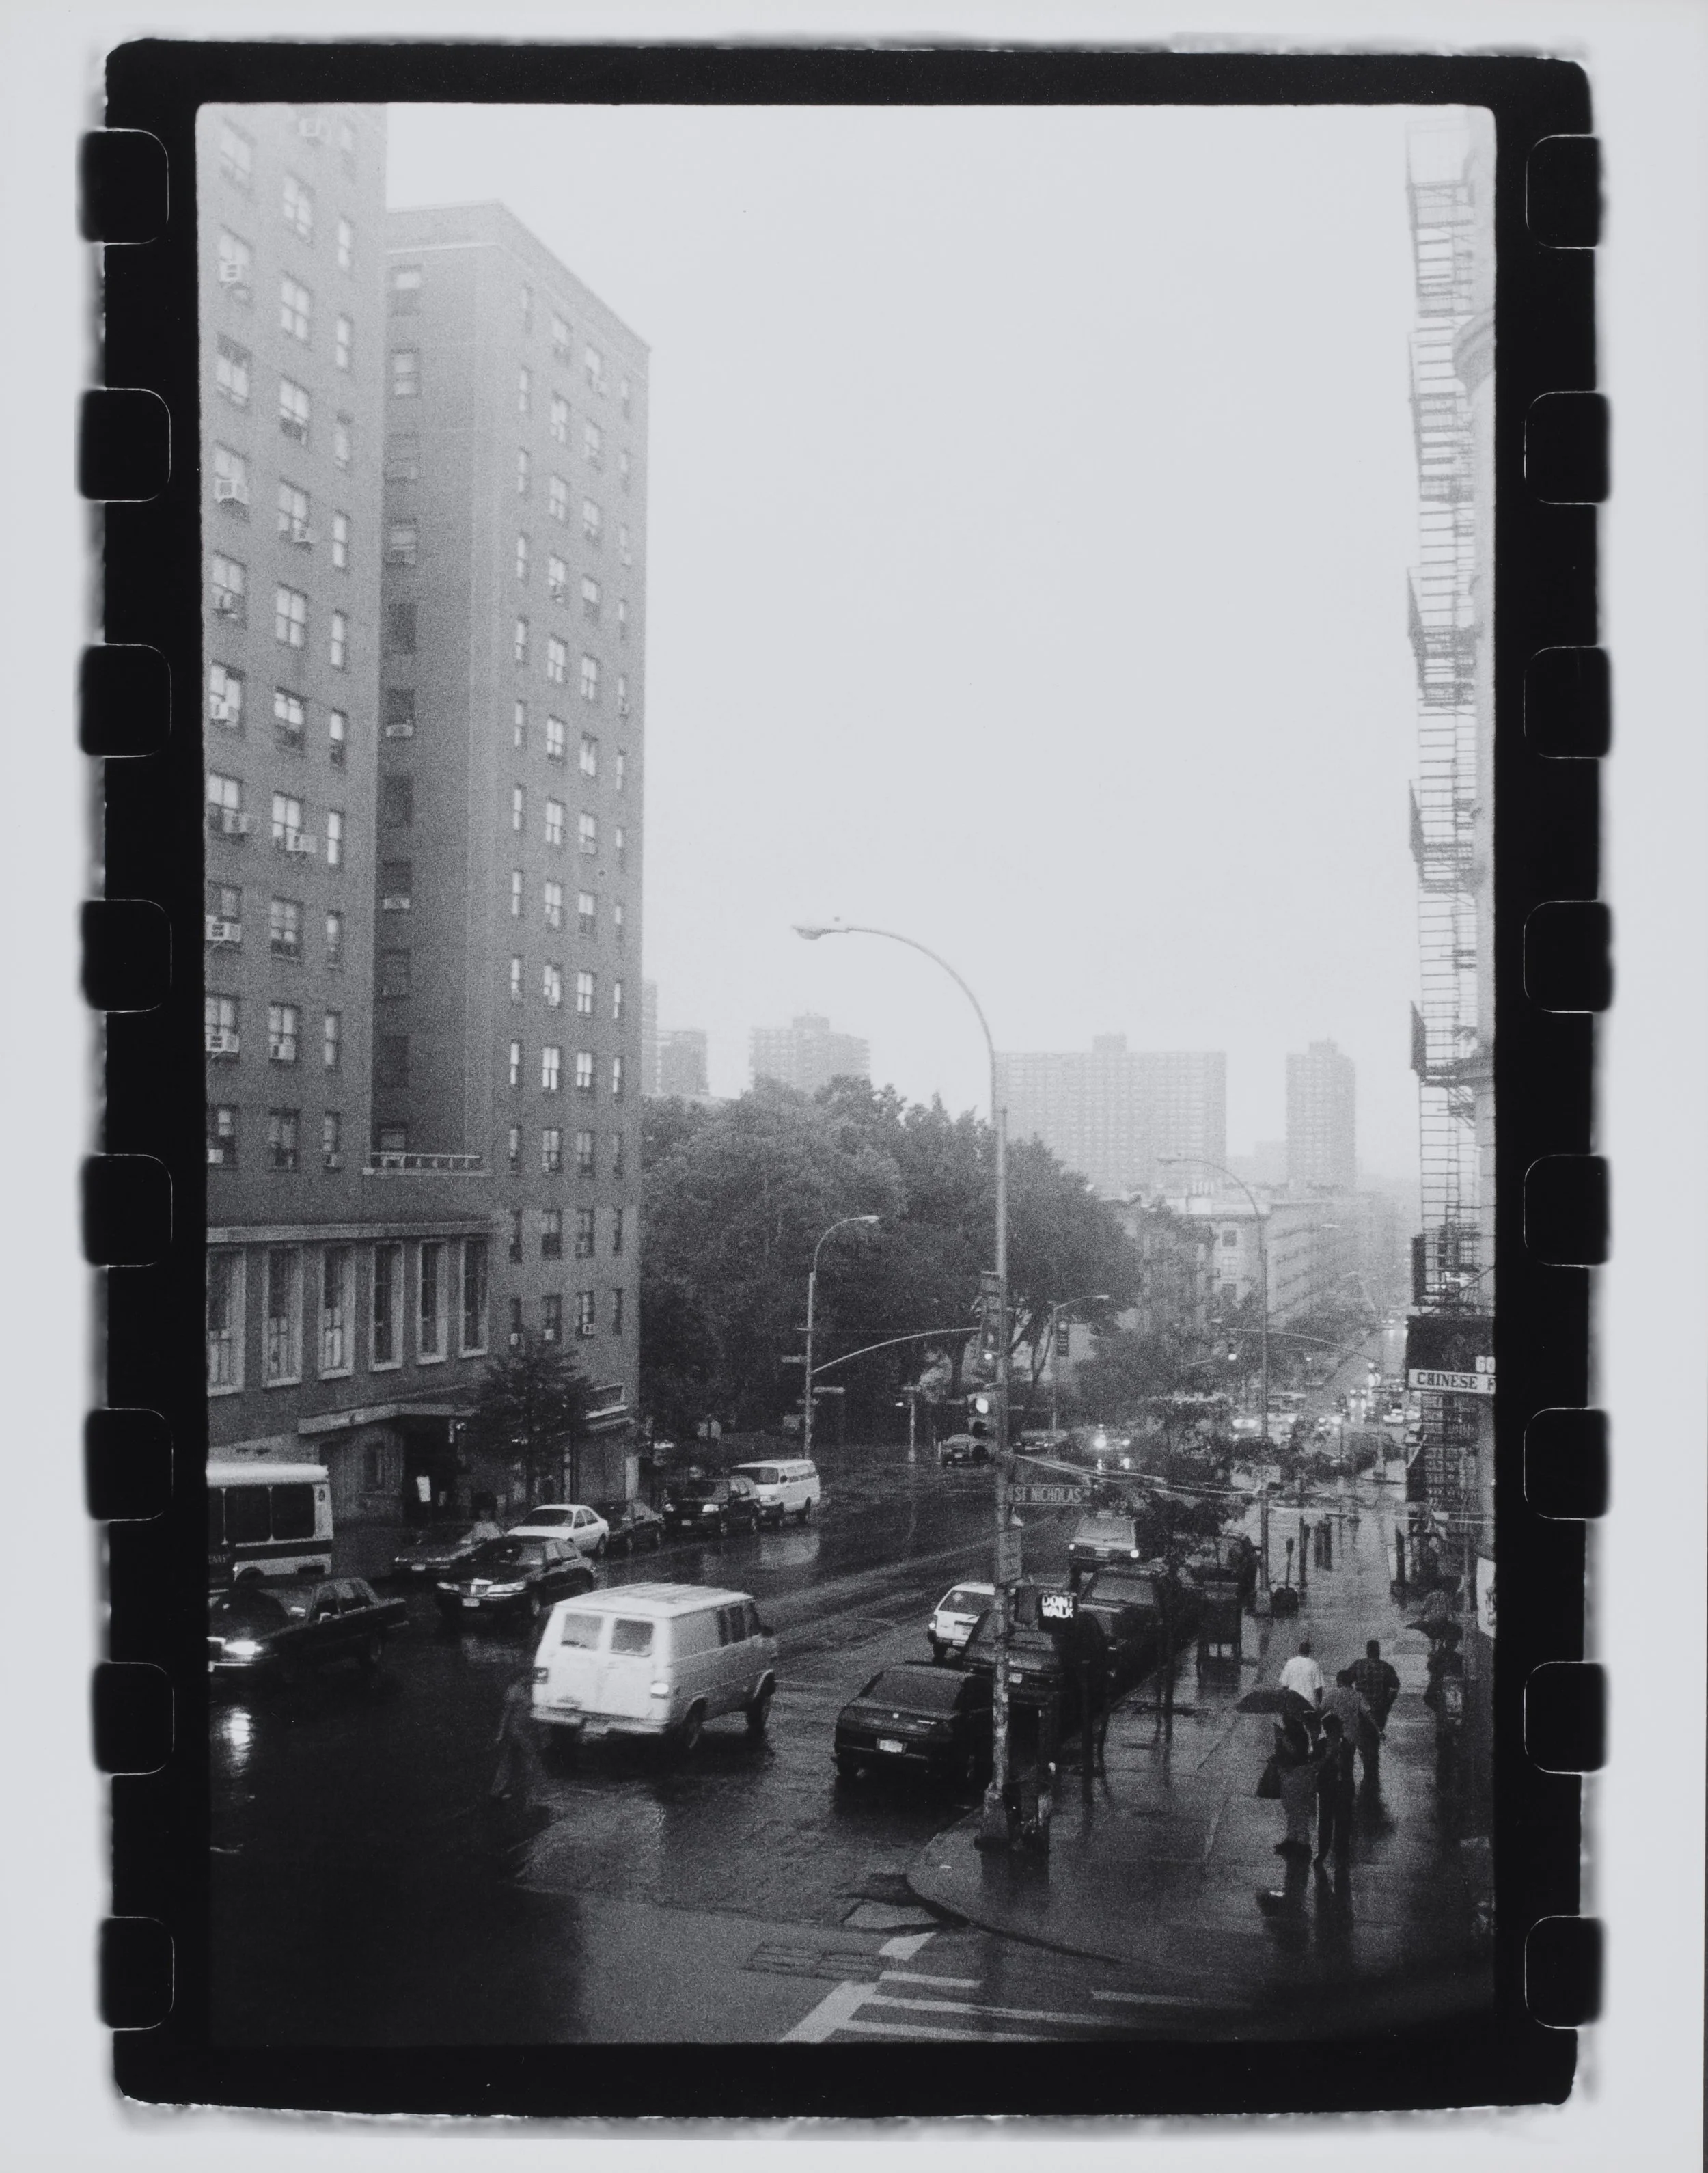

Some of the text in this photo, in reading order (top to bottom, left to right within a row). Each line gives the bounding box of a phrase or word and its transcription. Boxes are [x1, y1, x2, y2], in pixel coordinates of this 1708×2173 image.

[1418, 1371, 1478, 1390] CHINESE
[1030, 1487, 1082, 1503] NICHOLAS
[1042, 1606, 1073, 1618] WALK
